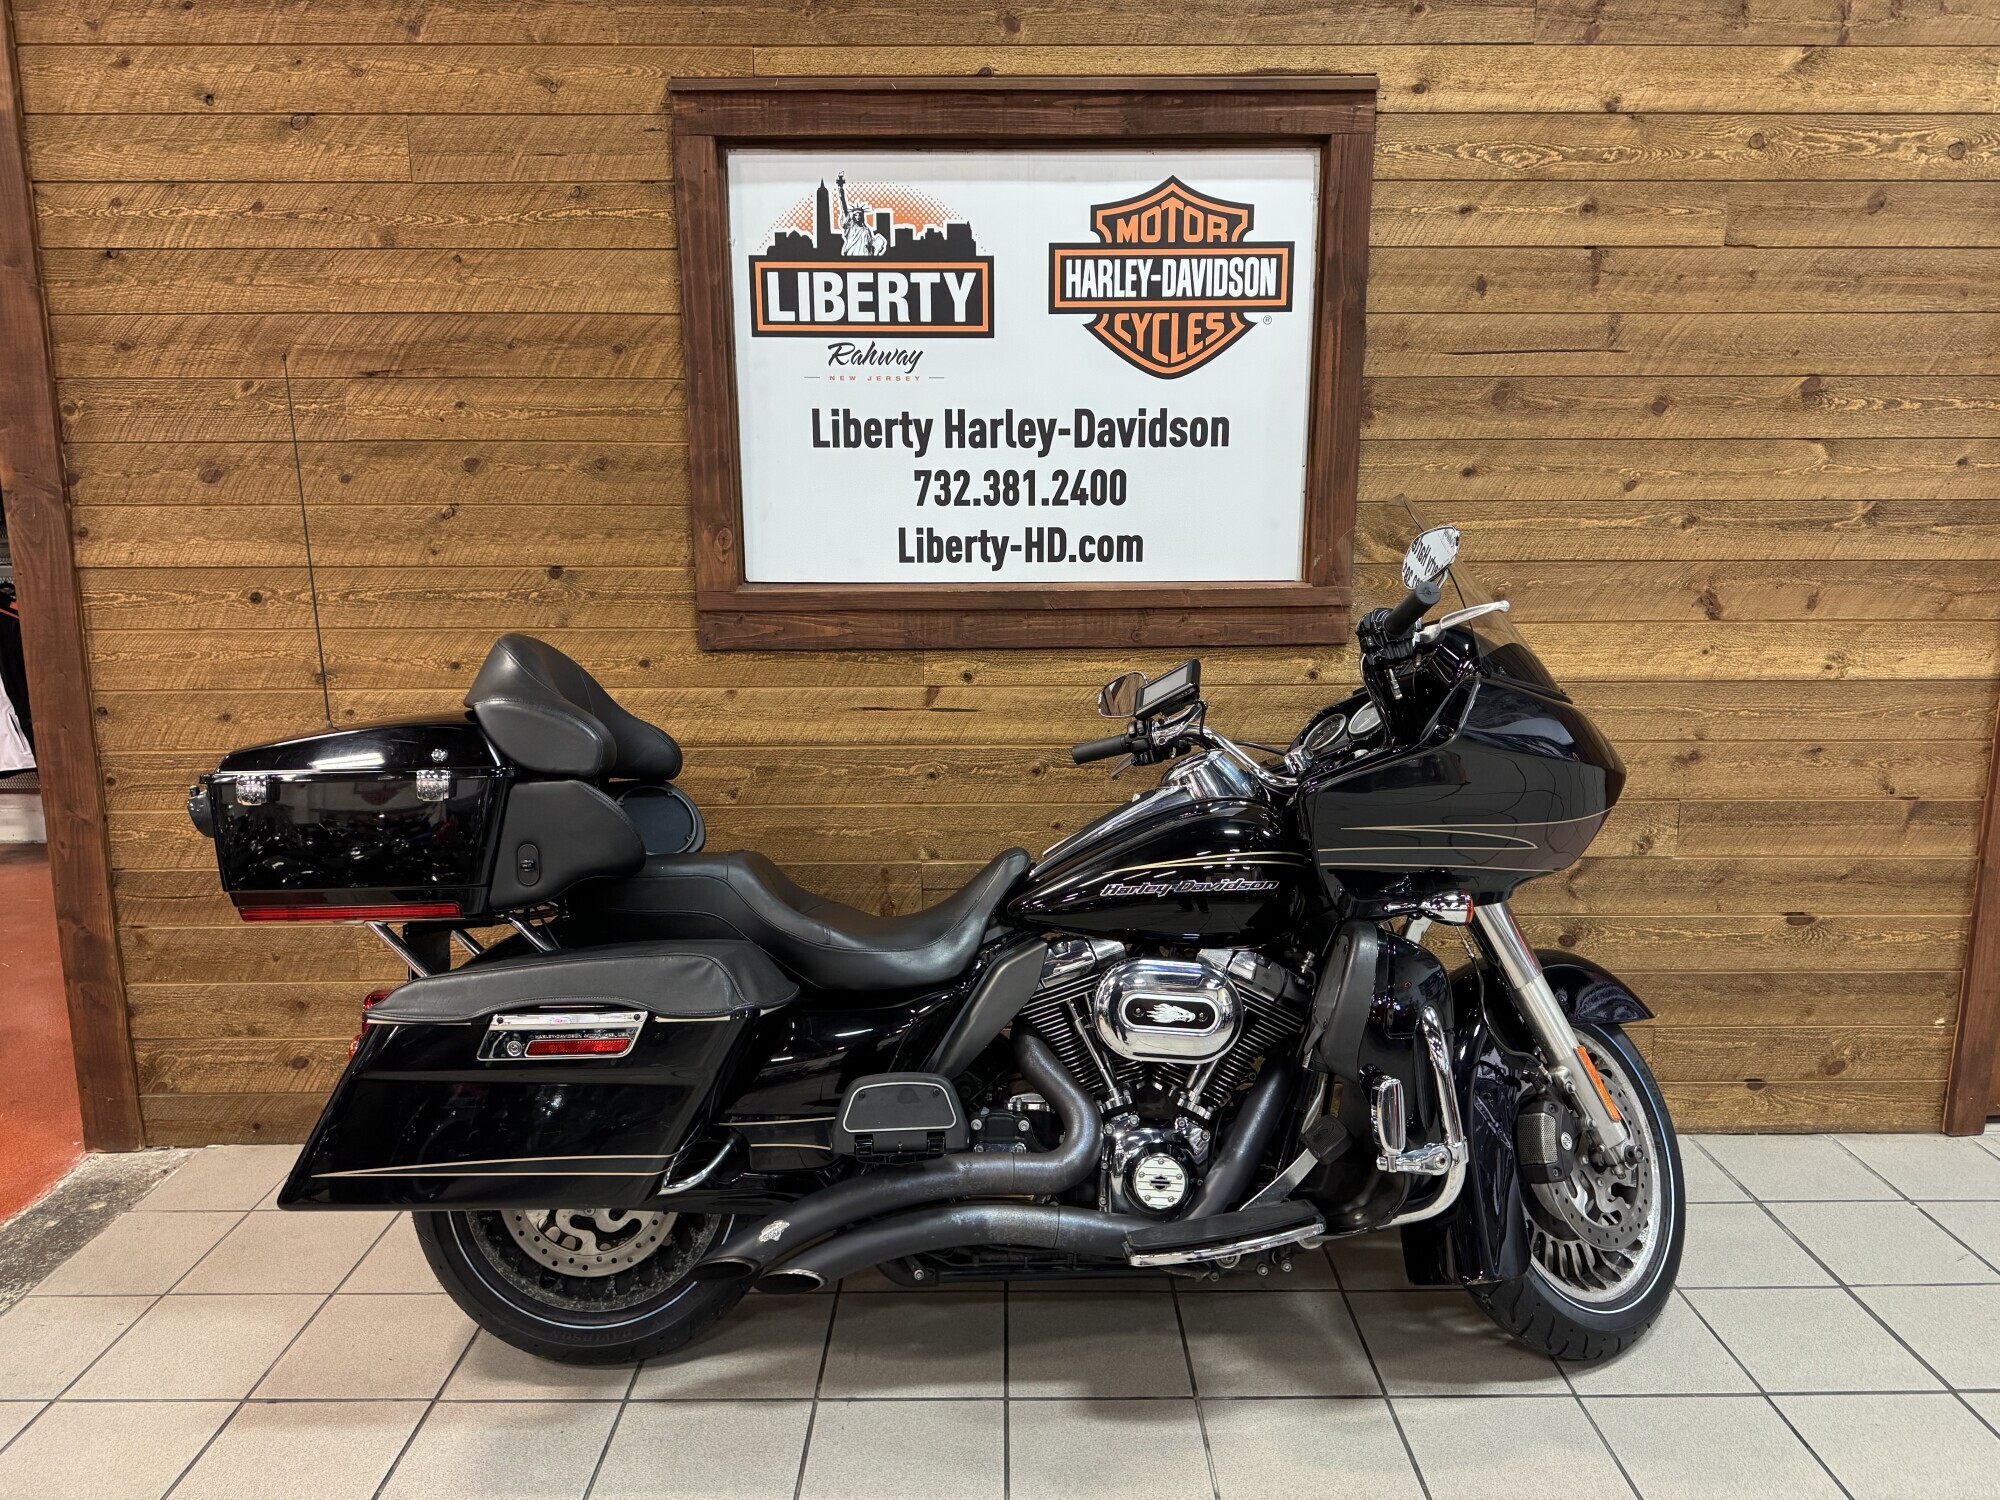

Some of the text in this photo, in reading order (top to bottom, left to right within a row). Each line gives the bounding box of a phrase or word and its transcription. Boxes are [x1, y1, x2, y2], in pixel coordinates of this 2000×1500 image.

[1116, 196, 1228, 243] MOTOR
[766, 271, 977, 323] LIBERTY
[1065, 256, 1278, 298] HARLEY-DAVIDSON
[827, 340, 924, 374] Rahway
[1114, 312, 1226, 364] CYCLES
[811, 407, 1231, 459] Liberty Harley-Davidson
[913, 468, 1128, 508] 732.381.2400
[898, 526, 1145, 572] Liberty-HD.com
[1100, 877, 1280, 898] Harley-Davidson
